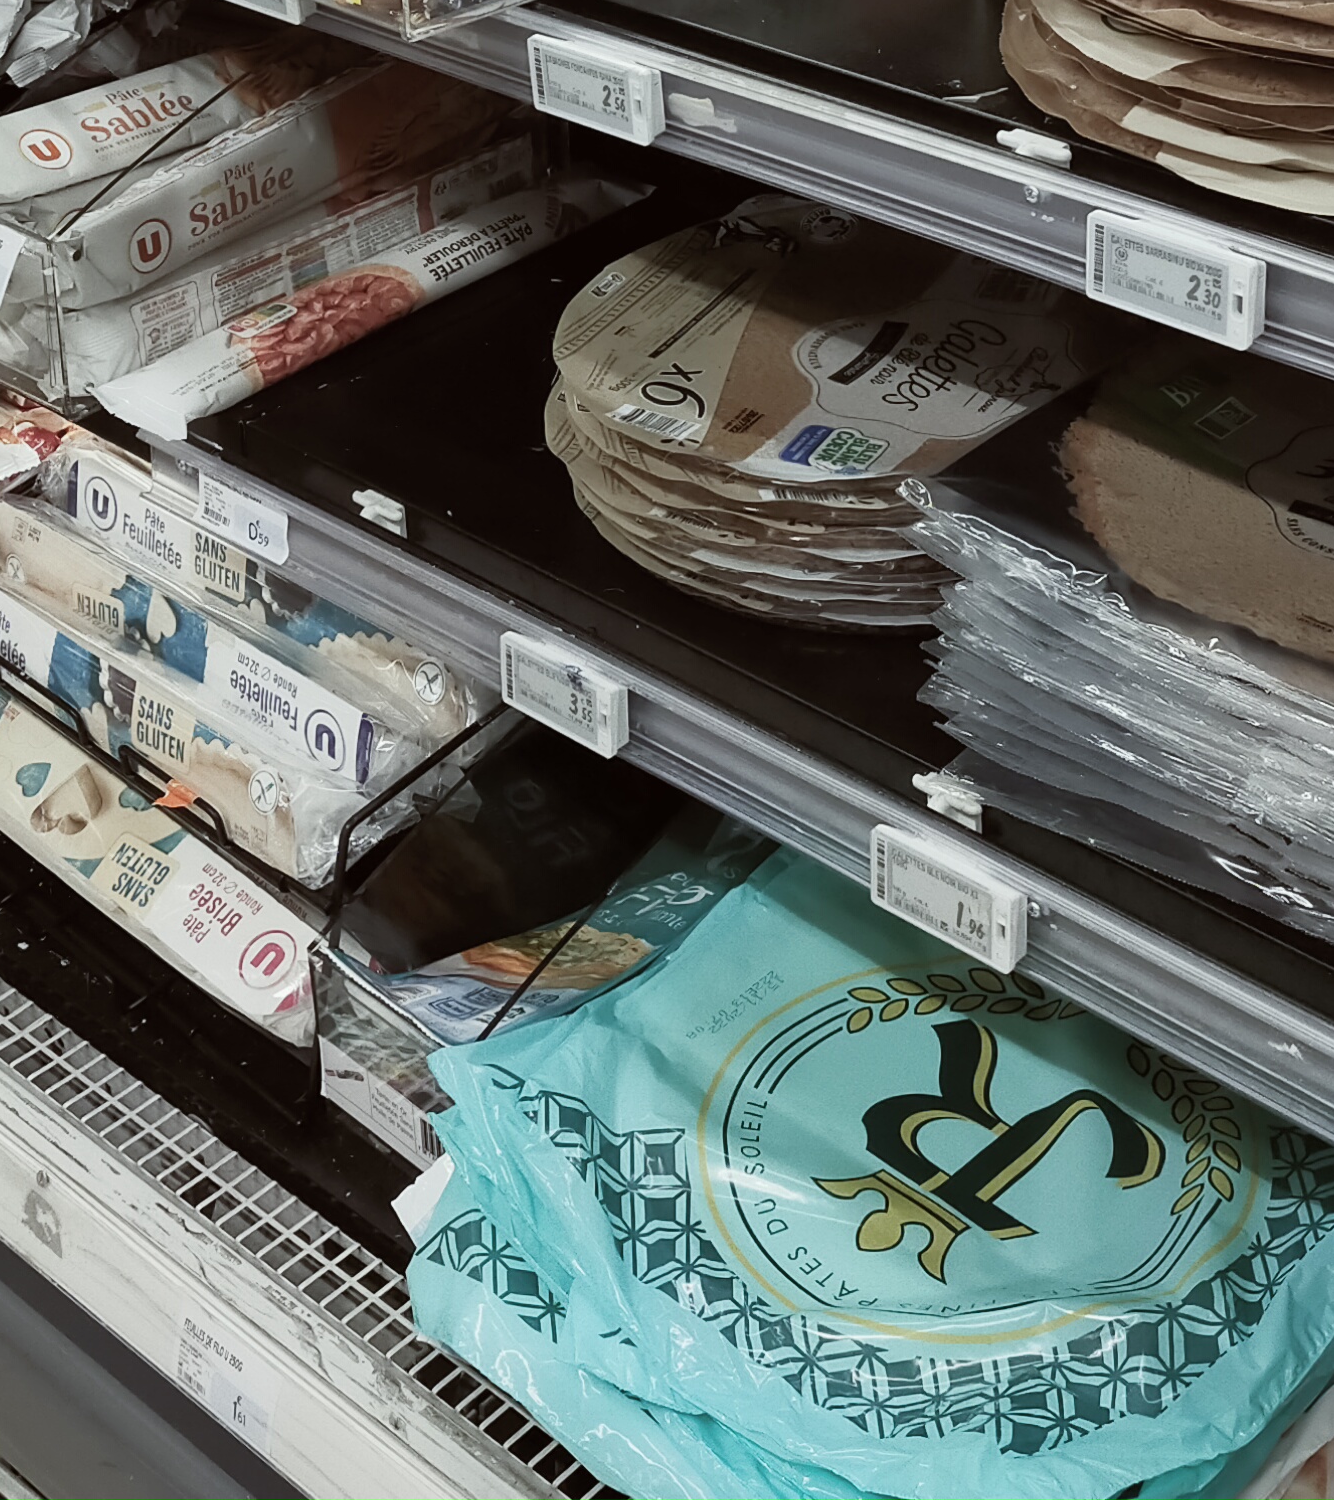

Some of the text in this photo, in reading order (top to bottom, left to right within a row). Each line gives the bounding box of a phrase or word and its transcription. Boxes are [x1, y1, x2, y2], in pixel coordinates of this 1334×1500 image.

[105, 86, 143, 107] Pâte
[80, 90, 193, 144] Sablée
[28, 137, 60, 162] U
[222, 156, 256, 183] Pâte
[188, 163, 295, 236] Sablée
[137, 228, 163, 263] U
[831, 437, 870, 467] BLANC
[852, 443, 883, 465] BLEU
[143, 507, 168, 534] Pâte
[121, 513, 183, 569] Feuilletée
[195, 532, 228, 563] SANS
[193, 557, 241, 594] GLUTEN
[138, 696, 174, 731] SANS
[229, 668, 300, 731] Feuilletée
[135, 717, 187, 764] GLUTEN
[111, 842, 172, 884] GLUTEN
[111, 872, 156, 909] SANS
[182, 912, 206, 944] Pâte
[188, 882, 243, 938] Brisée
[740, 1100, 769, 1177] SOLEIL
[755, 1198, 790, 1237] DU
